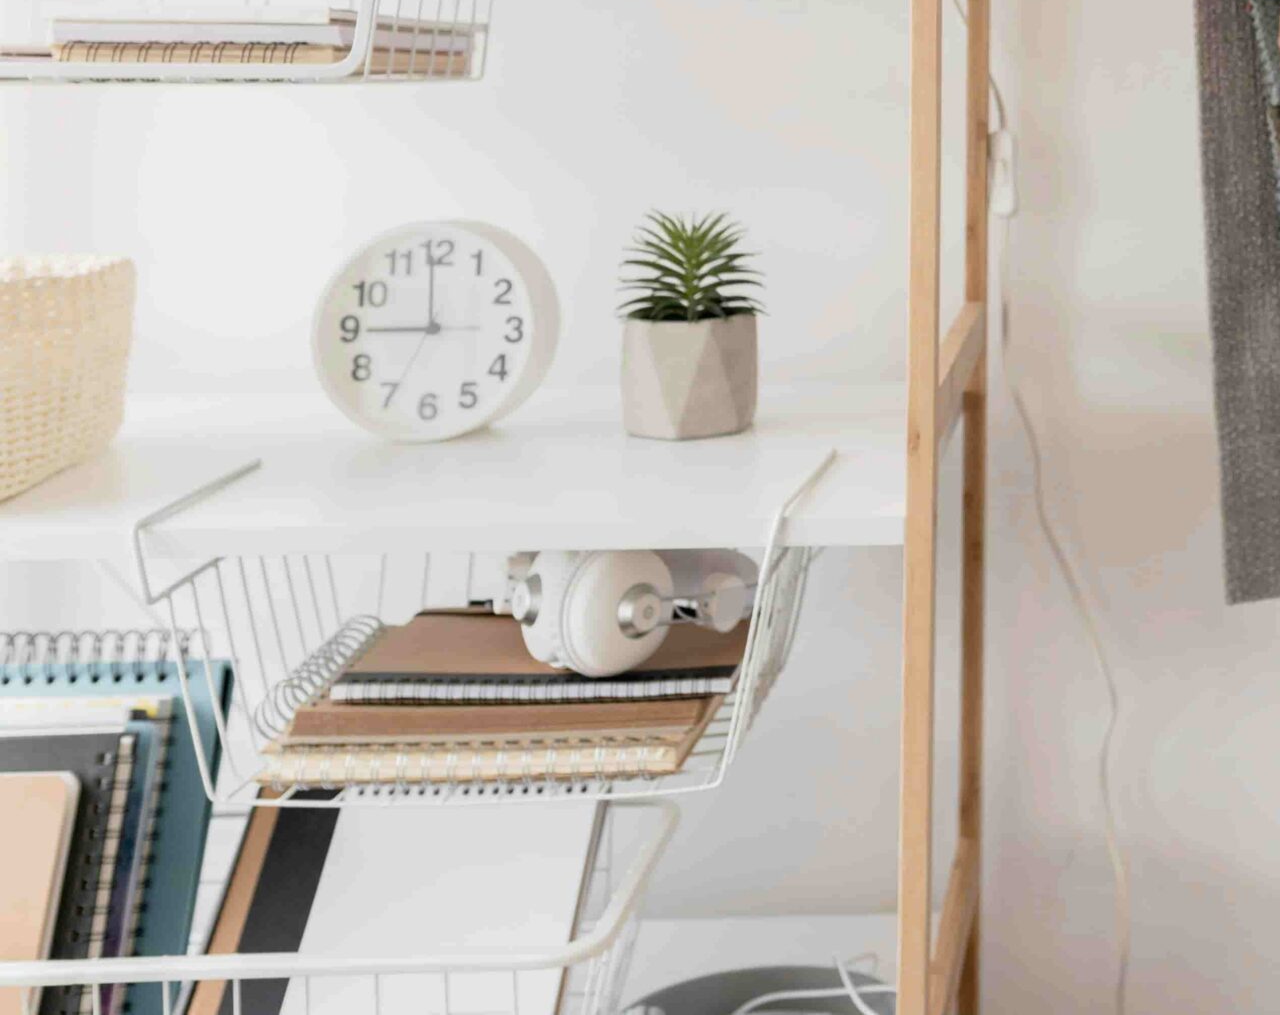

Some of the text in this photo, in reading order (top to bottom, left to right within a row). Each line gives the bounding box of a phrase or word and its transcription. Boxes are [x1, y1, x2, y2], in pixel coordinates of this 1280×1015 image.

[385, 249, 412, 276] 11
[420, 240, 455, 266] 12
[471, 249, 482, 276] 1
[352, 281, 387, 307] 10
[493, 278, 512, 304] 2
[340, 315, 360, 343] 9
[504, 316, 523, 343] 3
[352, 354, 371, 381] 8
[488, 354, 508, 381] 4
[381, 383, 400, 409] 7
[417, 393, 438, 420] 6
[459, 382, 478, 409] 5
